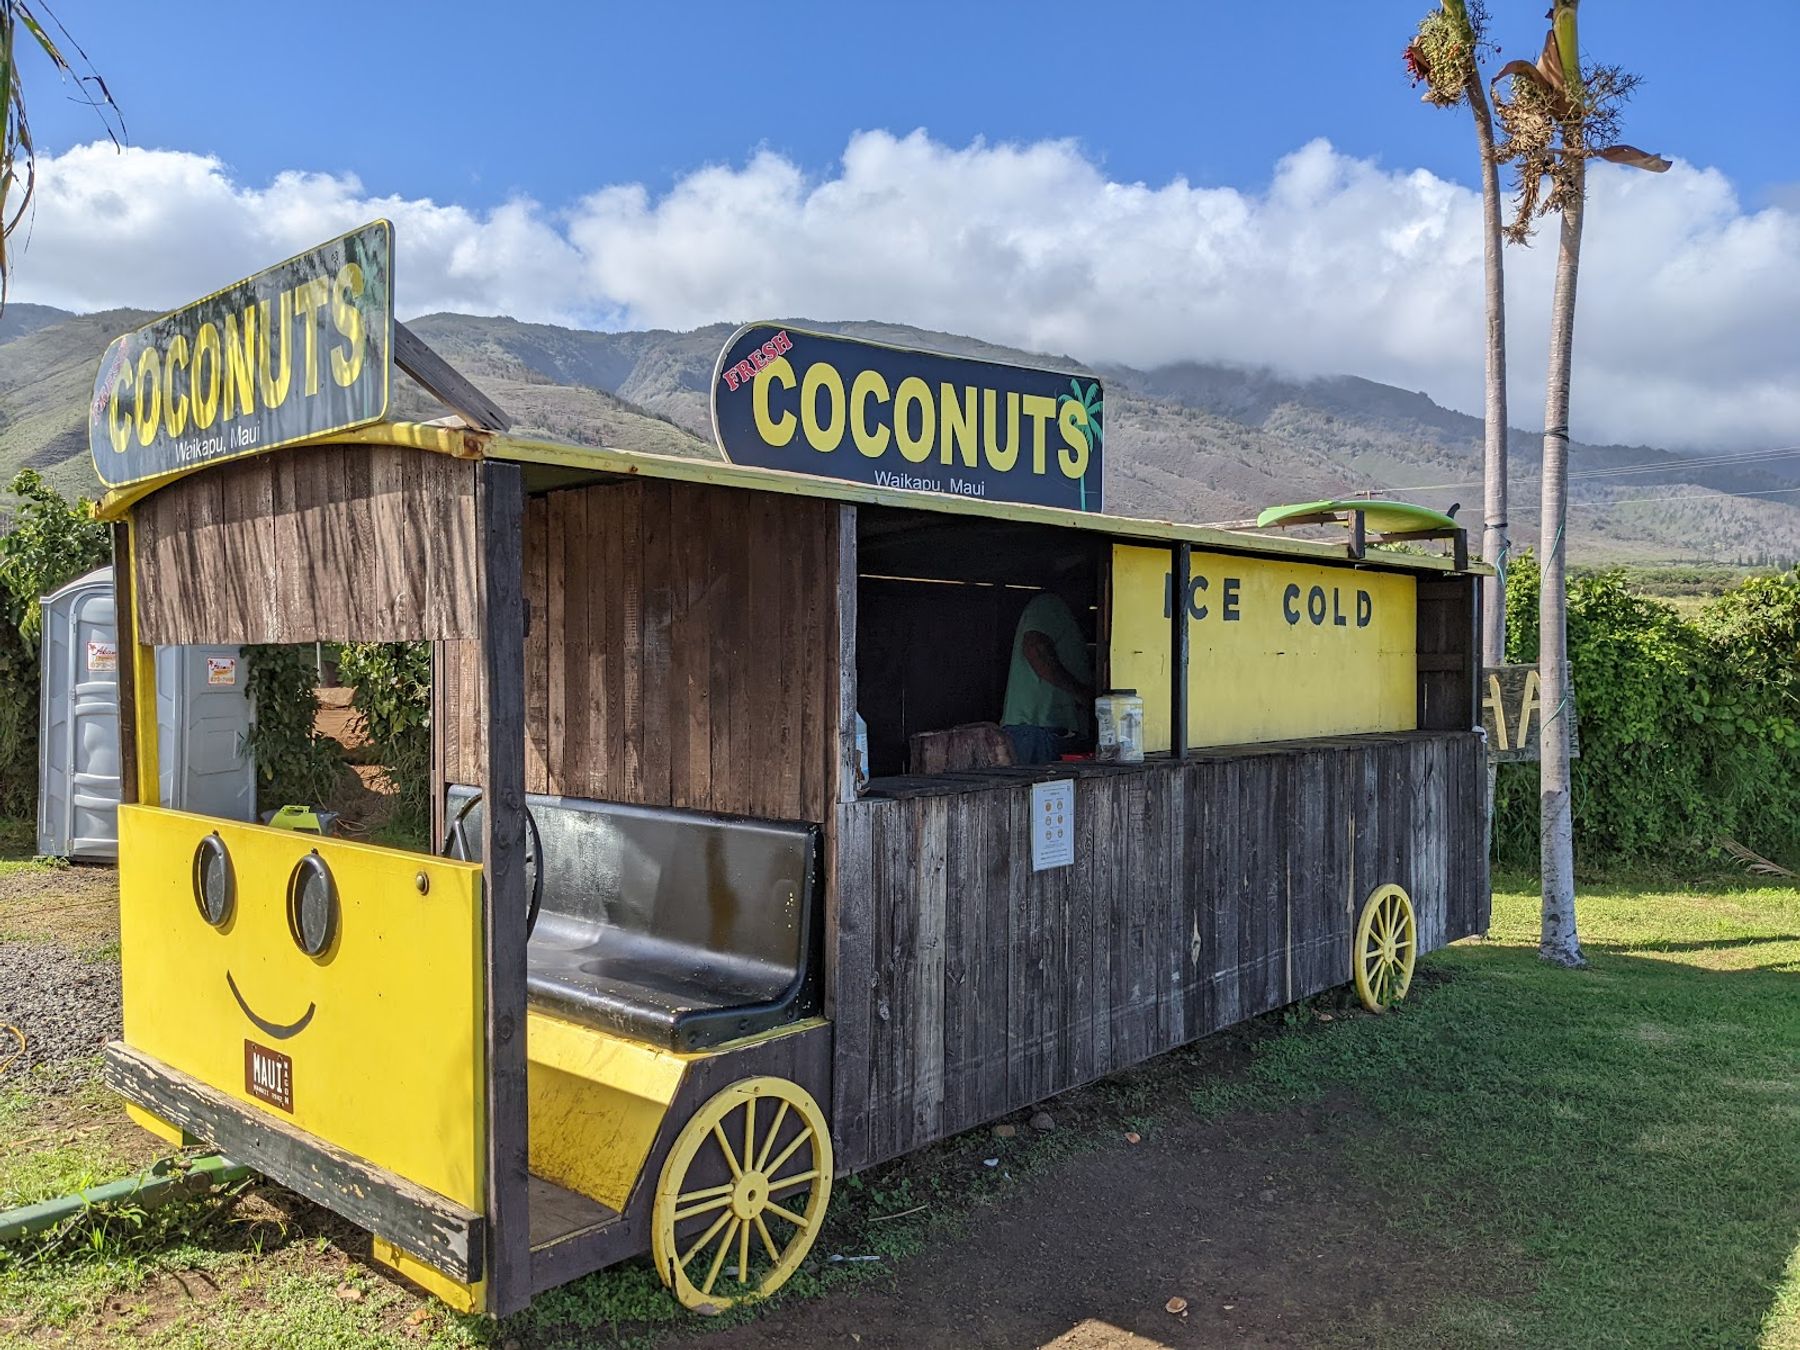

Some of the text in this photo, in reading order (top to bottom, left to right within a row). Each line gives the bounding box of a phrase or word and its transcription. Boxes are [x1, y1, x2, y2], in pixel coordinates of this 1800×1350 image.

[108, 262, 366, 454] COCONUTS
[722, 330, 794, 391] FRESH
[175, 420, 260, 463] Waikapu, Maui
[752, 355, 1090, 480] COCONUTS
[874, 470, 985, 496] Waikapu, Maui
[1163, 571, 1373, 628] ICE COLD
[253, 1052, 283, 1094] MAUI
